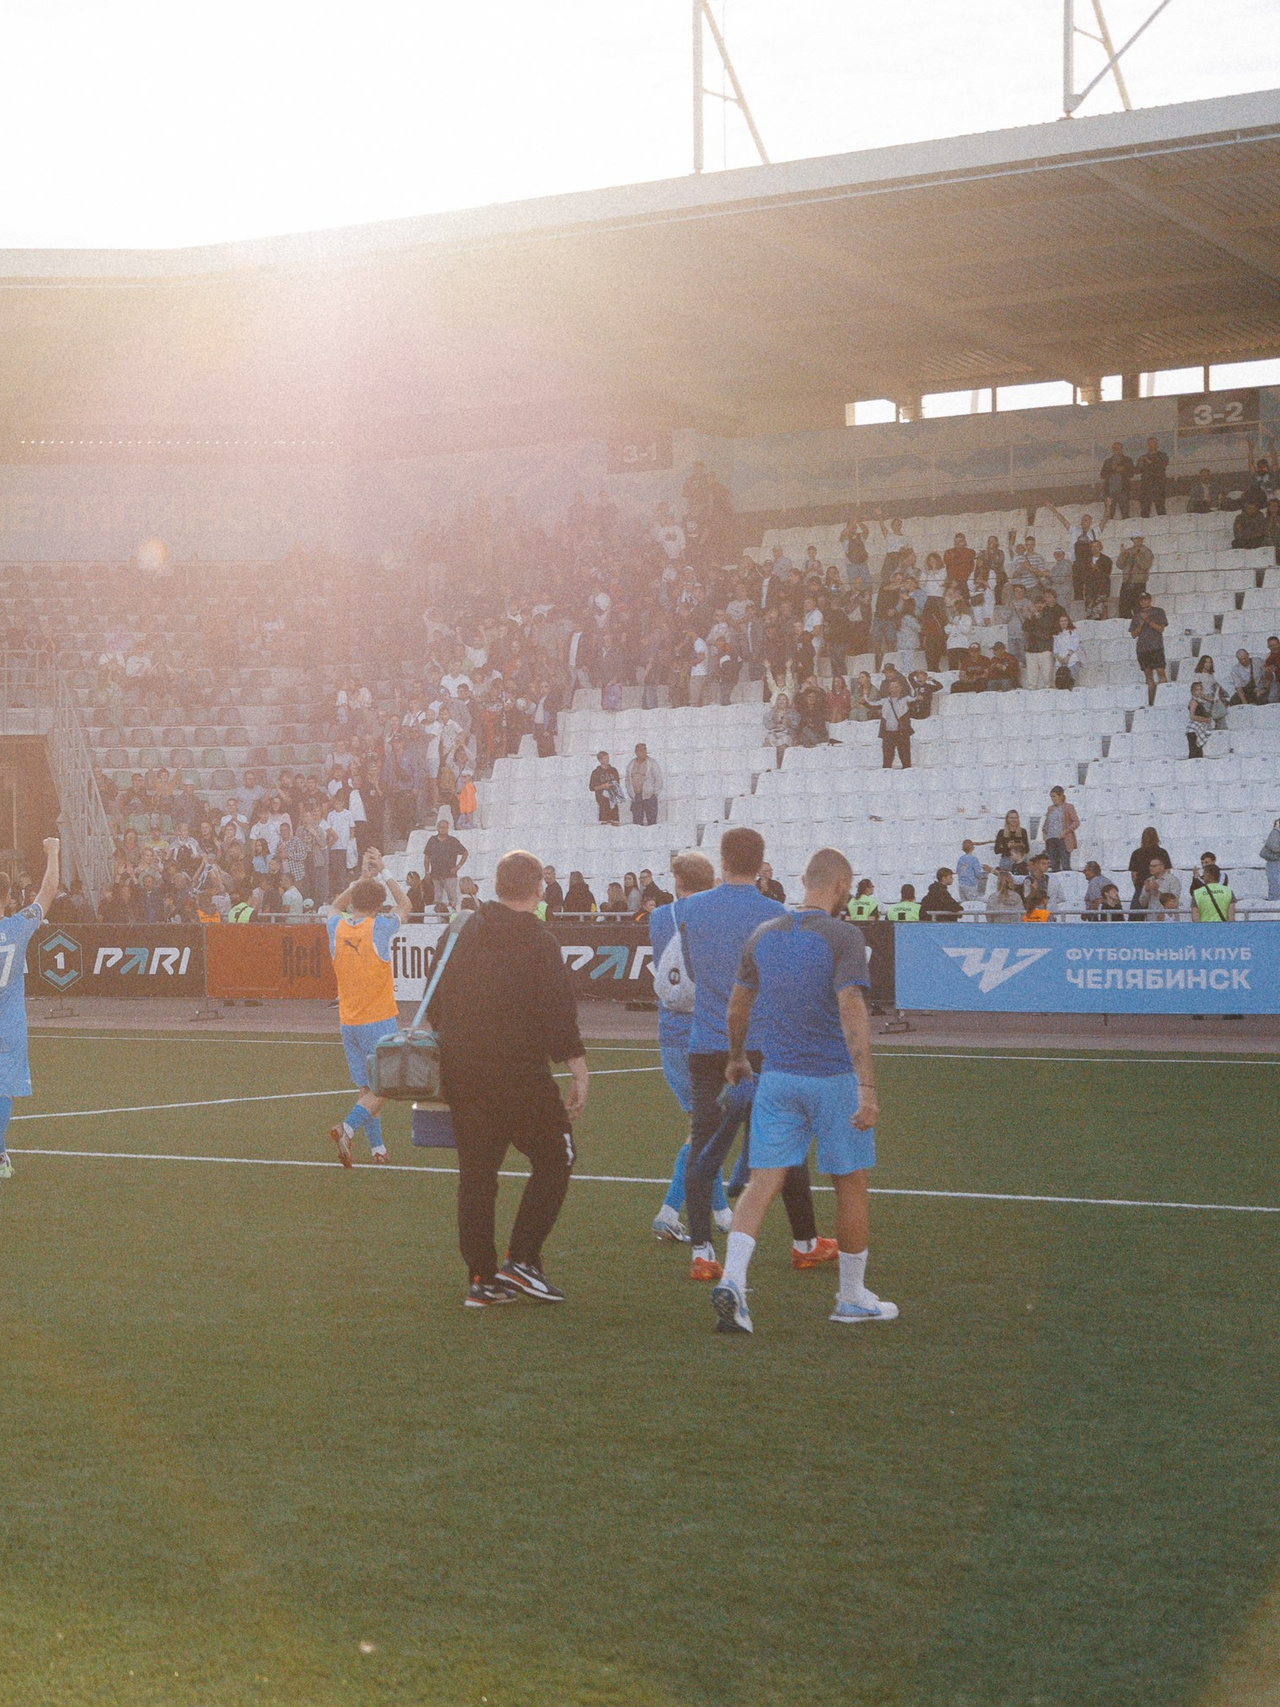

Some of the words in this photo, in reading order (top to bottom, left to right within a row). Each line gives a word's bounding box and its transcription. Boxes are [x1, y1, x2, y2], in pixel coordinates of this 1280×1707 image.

[93, 946, 191, 975] PARI
[1066, 945, 1197, 961] ФУТБОЛЬНЫЙ
[1202, 947, 1252, 961] КЛУБ
[1066, 968, 1252, 990] ЧЕЛЯБИНСК
